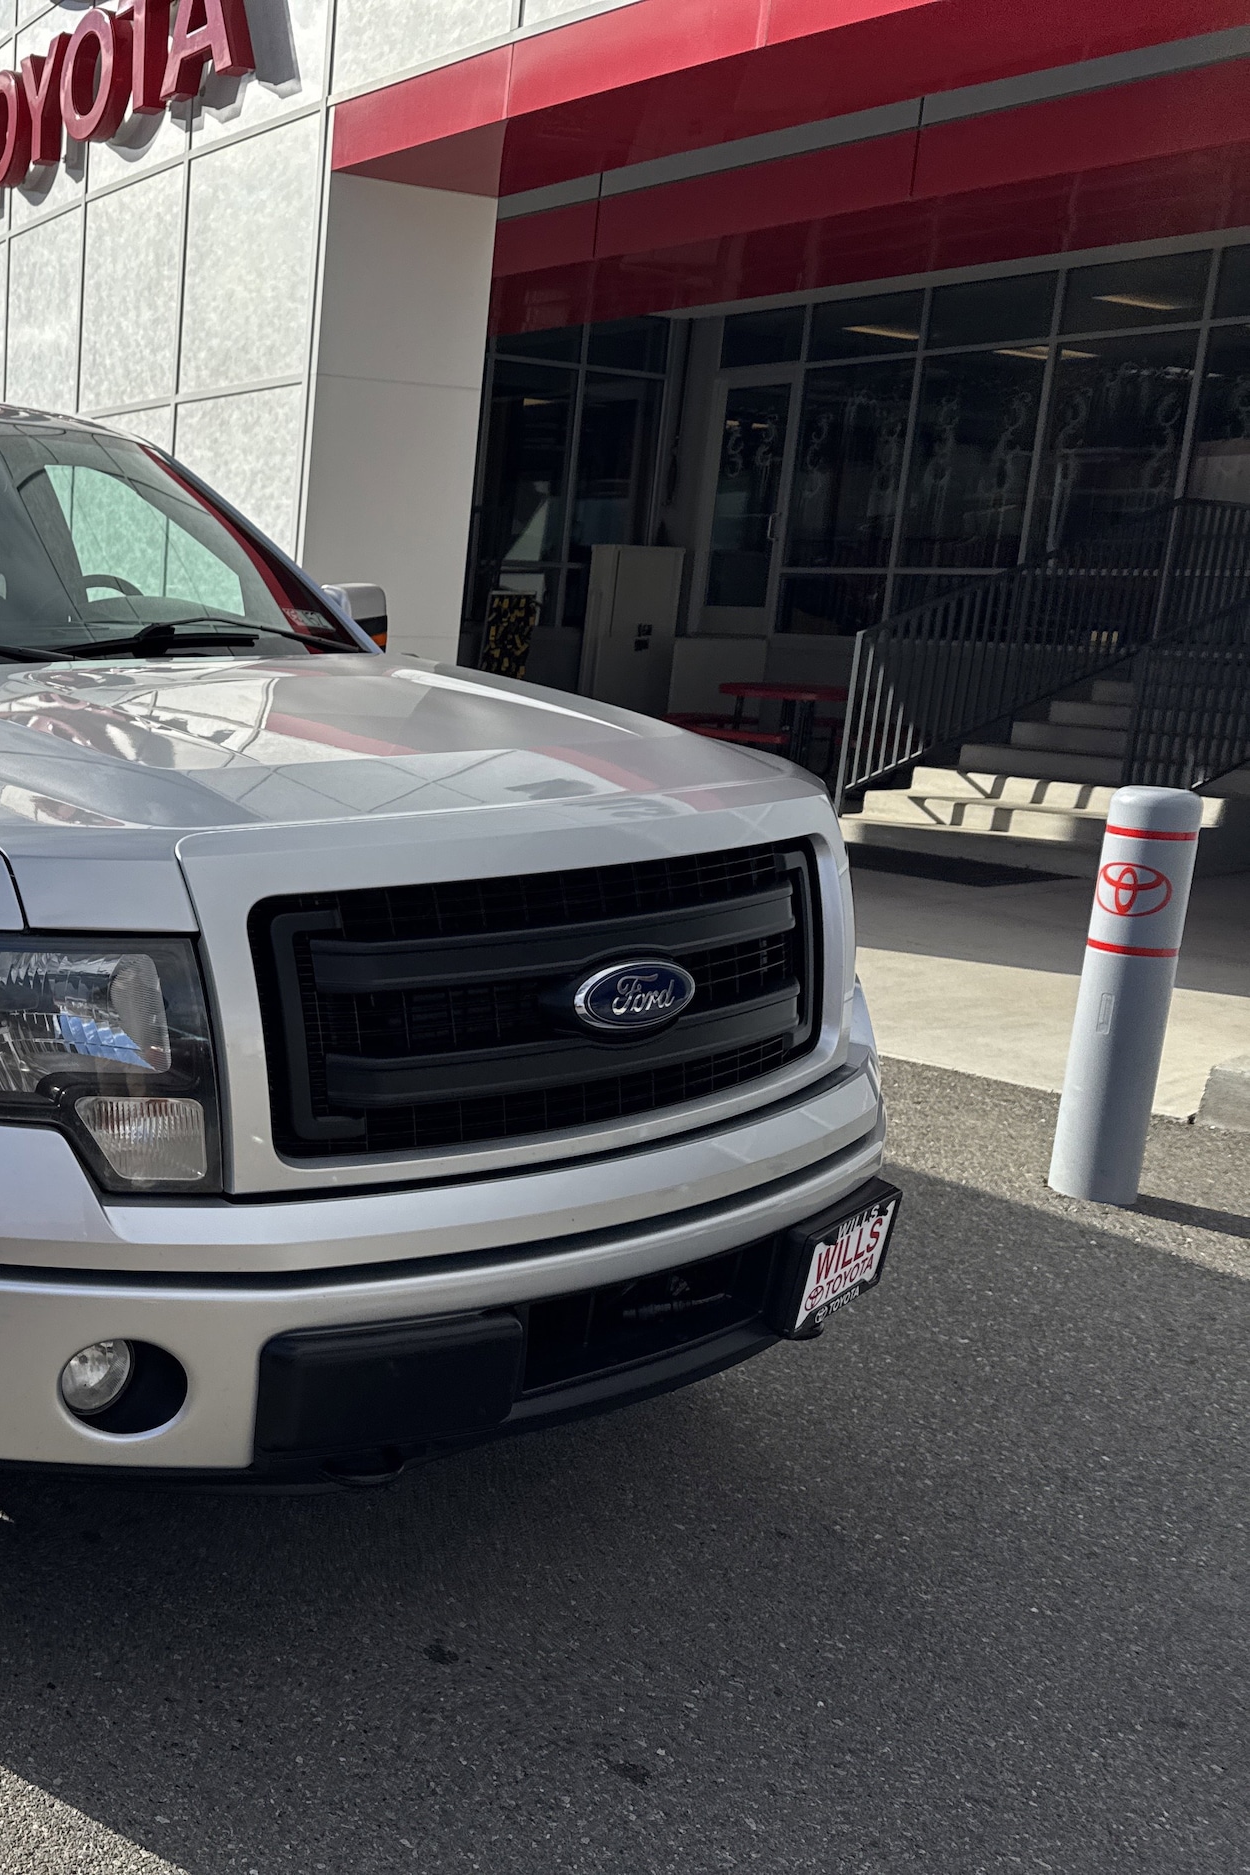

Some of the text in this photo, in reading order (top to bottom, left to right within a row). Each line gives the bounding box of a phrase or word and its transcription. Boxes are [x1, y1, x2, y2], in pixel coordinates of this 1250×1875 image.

[612, 973, 675, 1016] Ford
[838, 1204, 880, 1240] WILLS
[816, 1217, 883, 1285] WILLS
[825, 1253, 874, 1299] TOYOTA
[828, 1286, 860, 1314] TOYOTA
